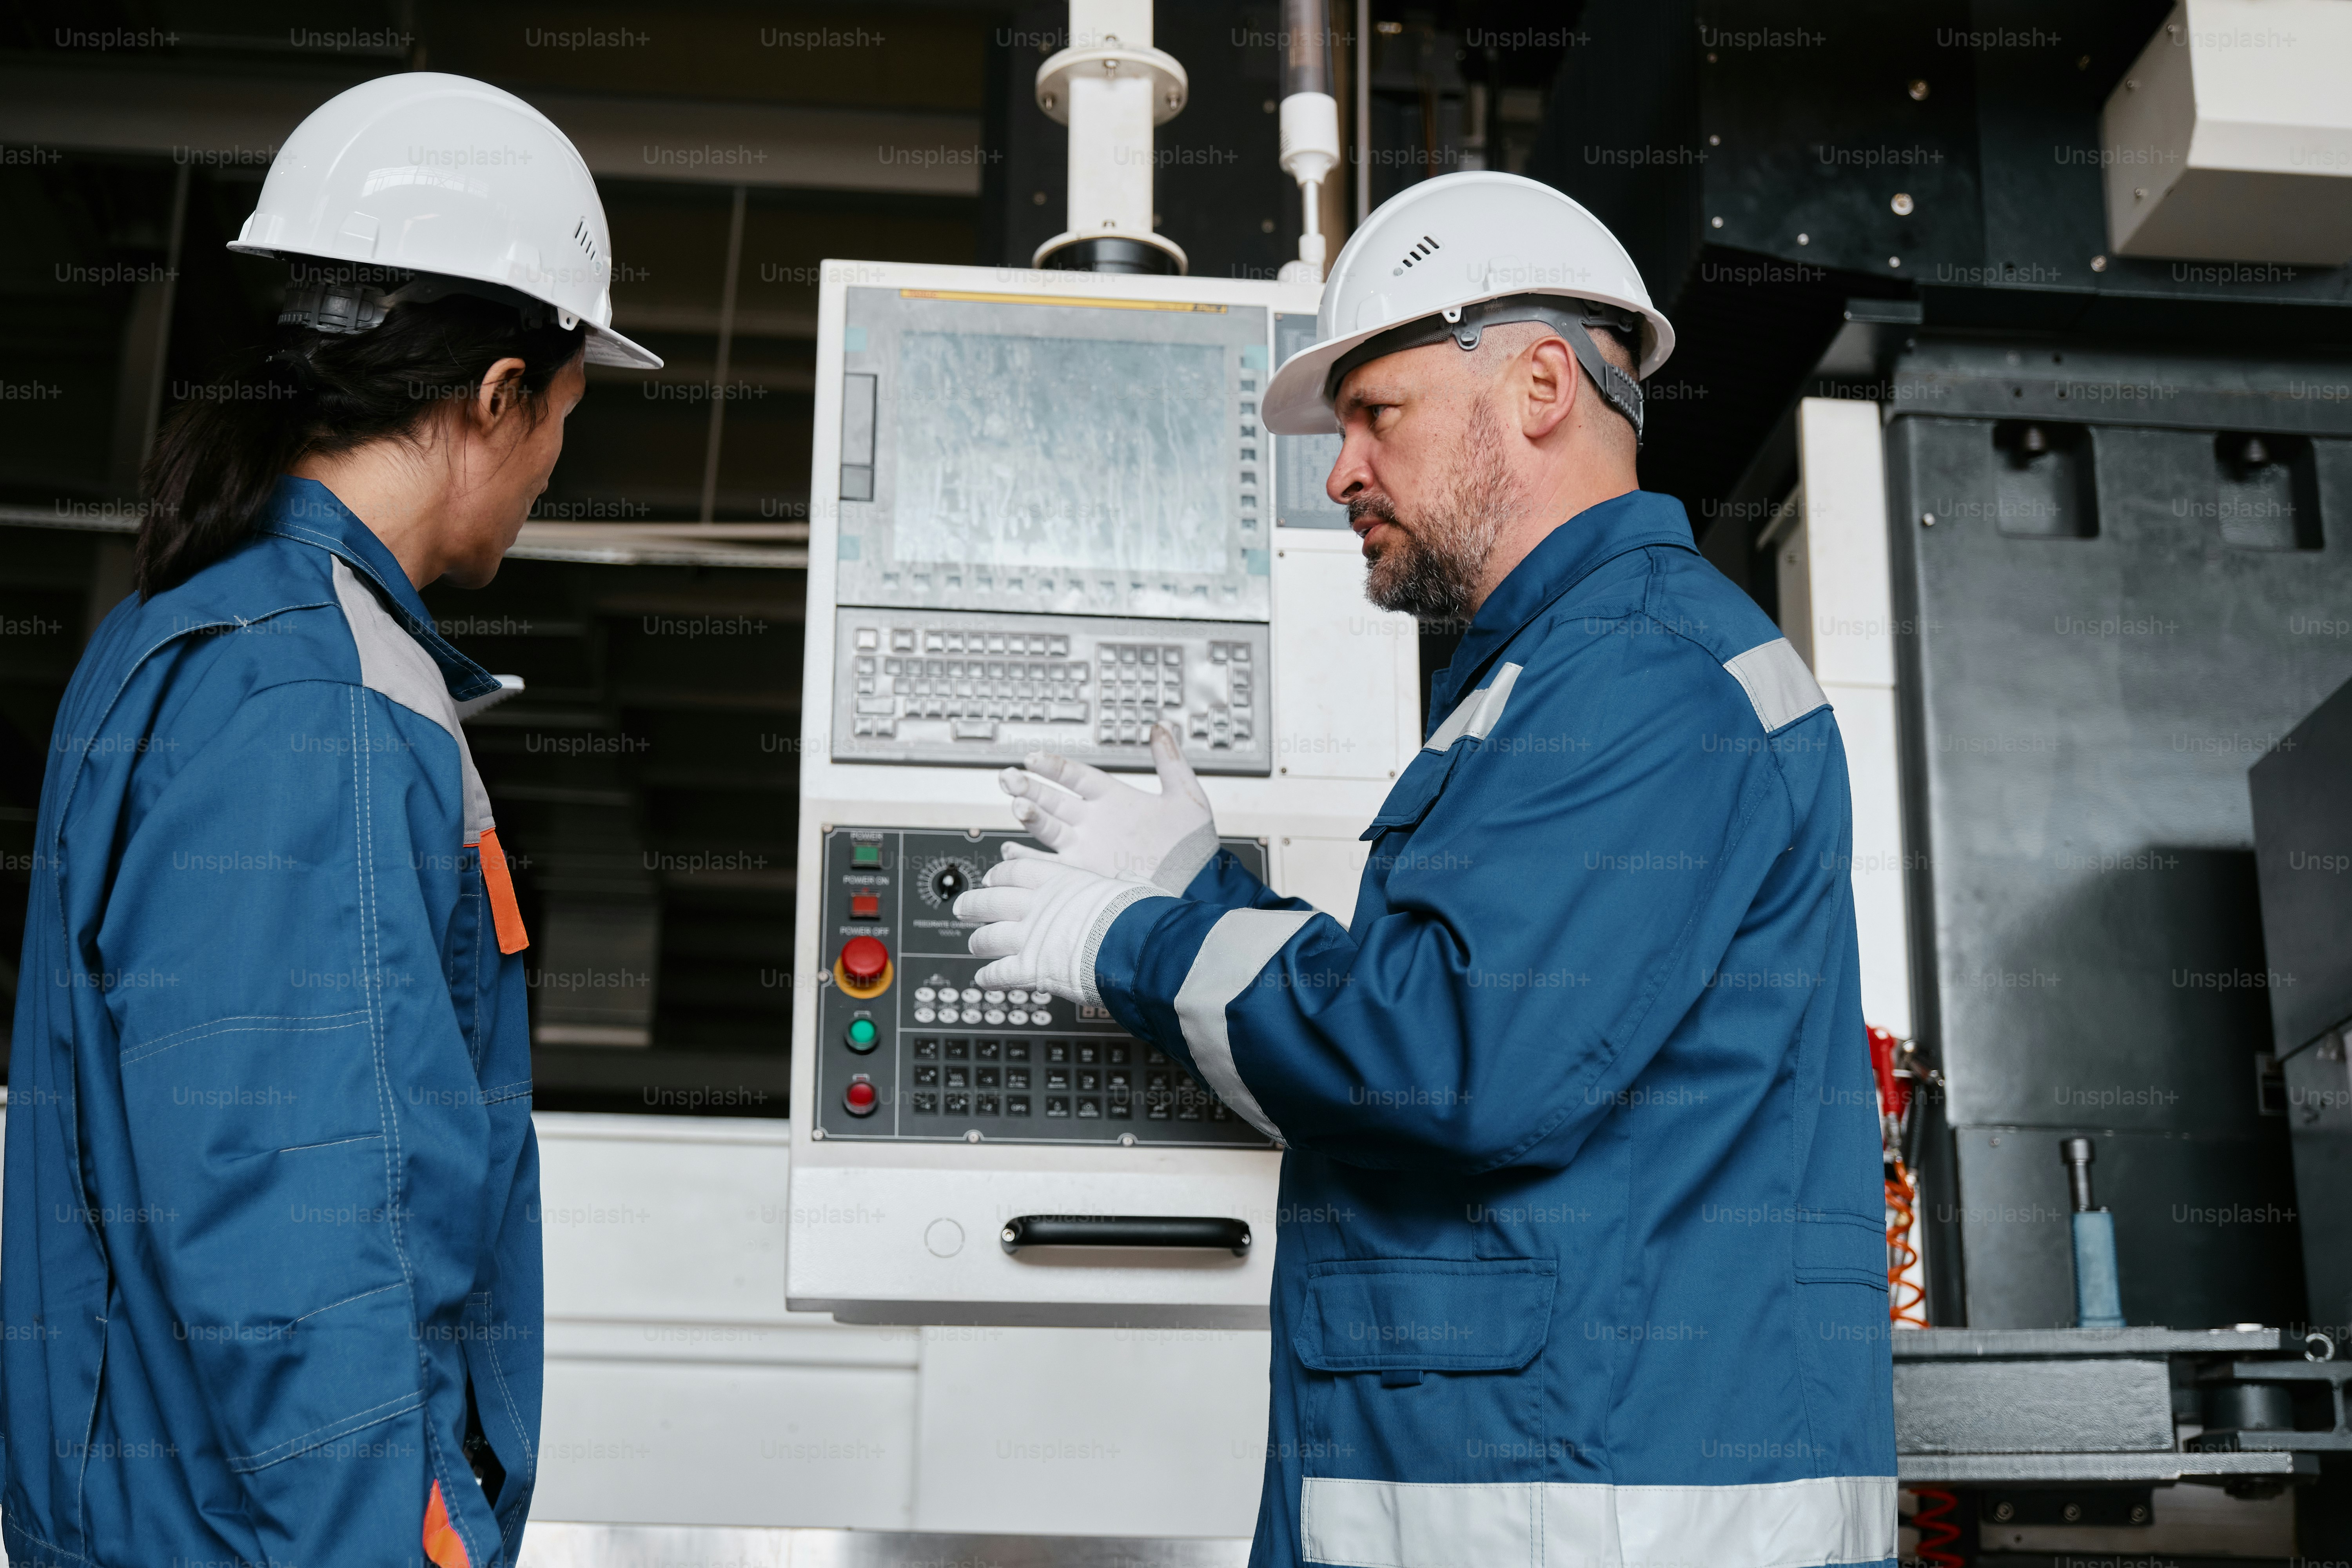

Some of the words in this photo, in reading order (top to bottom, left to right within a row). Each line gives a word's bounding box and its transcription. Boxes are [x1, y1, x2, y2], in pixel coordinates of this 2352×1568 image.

[850, 831, 883, 840] POWER
[843, 875, 875, 884] POWER
[875, 876, 889, 885] ON
[840, 926, 871, 936] POWER
[872, 927, 890, 936] OFF
